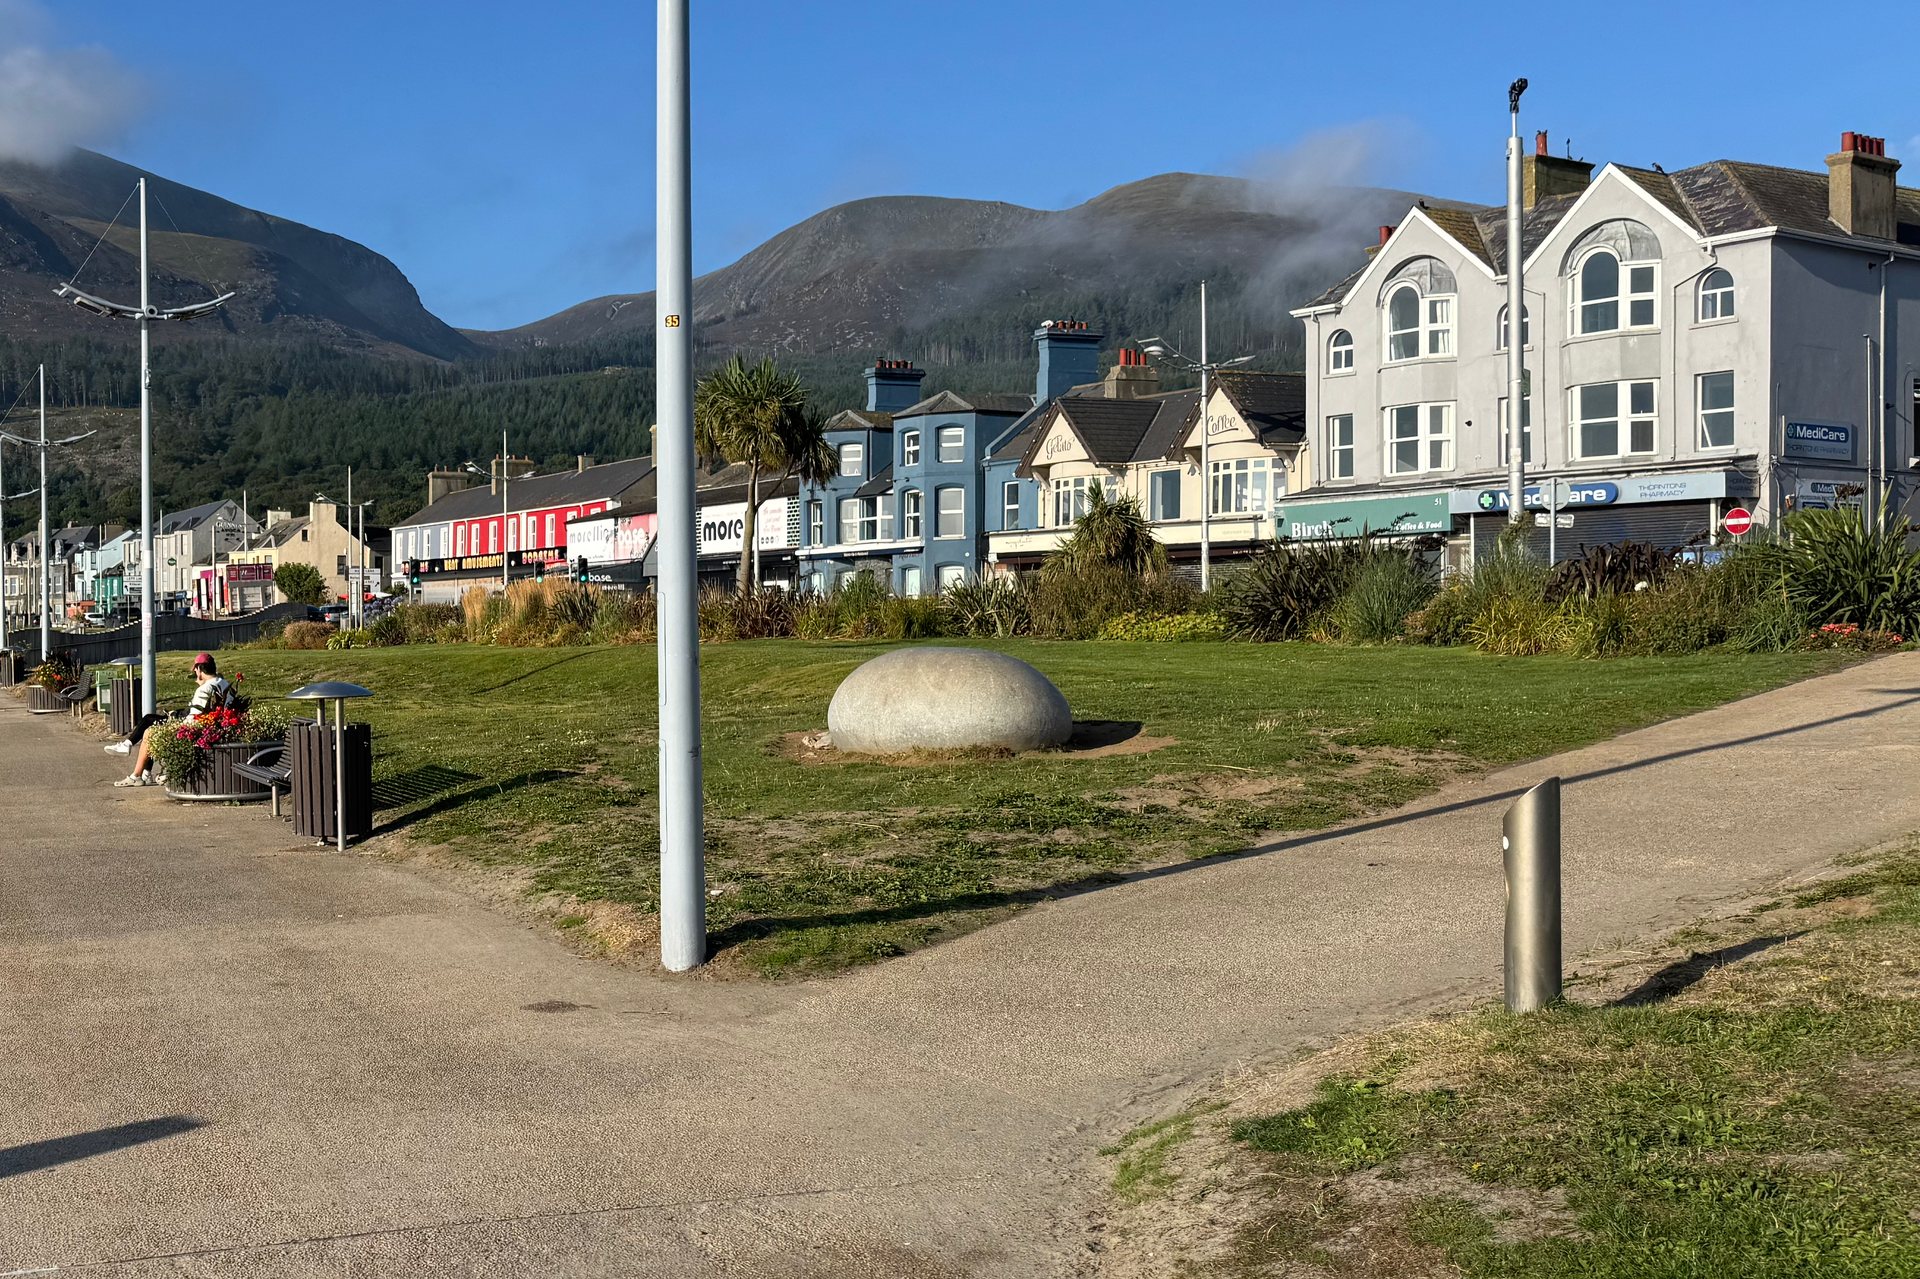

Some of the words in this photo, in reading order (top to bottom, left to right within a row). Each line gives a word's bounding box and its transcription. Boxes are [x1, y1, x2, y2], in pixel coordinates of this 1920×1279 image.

[666, 315, 679, 327] 35
[1207, 414, 1238, 436] Coffee
[1796, 425, 1846, 441] MediCare
[1638, 482, 1687, 491] THORNTONS
[1640, 490, 1685, 498] PHARMACY
[1434, 497, 1442, 506] 51
[1291, 520, 1333, 538] Birch
[1417, 521, 1425, 529] &
[1425, 520, 1443, 529] Food
[462, 554, 503, 570] AMUSEMENTS
